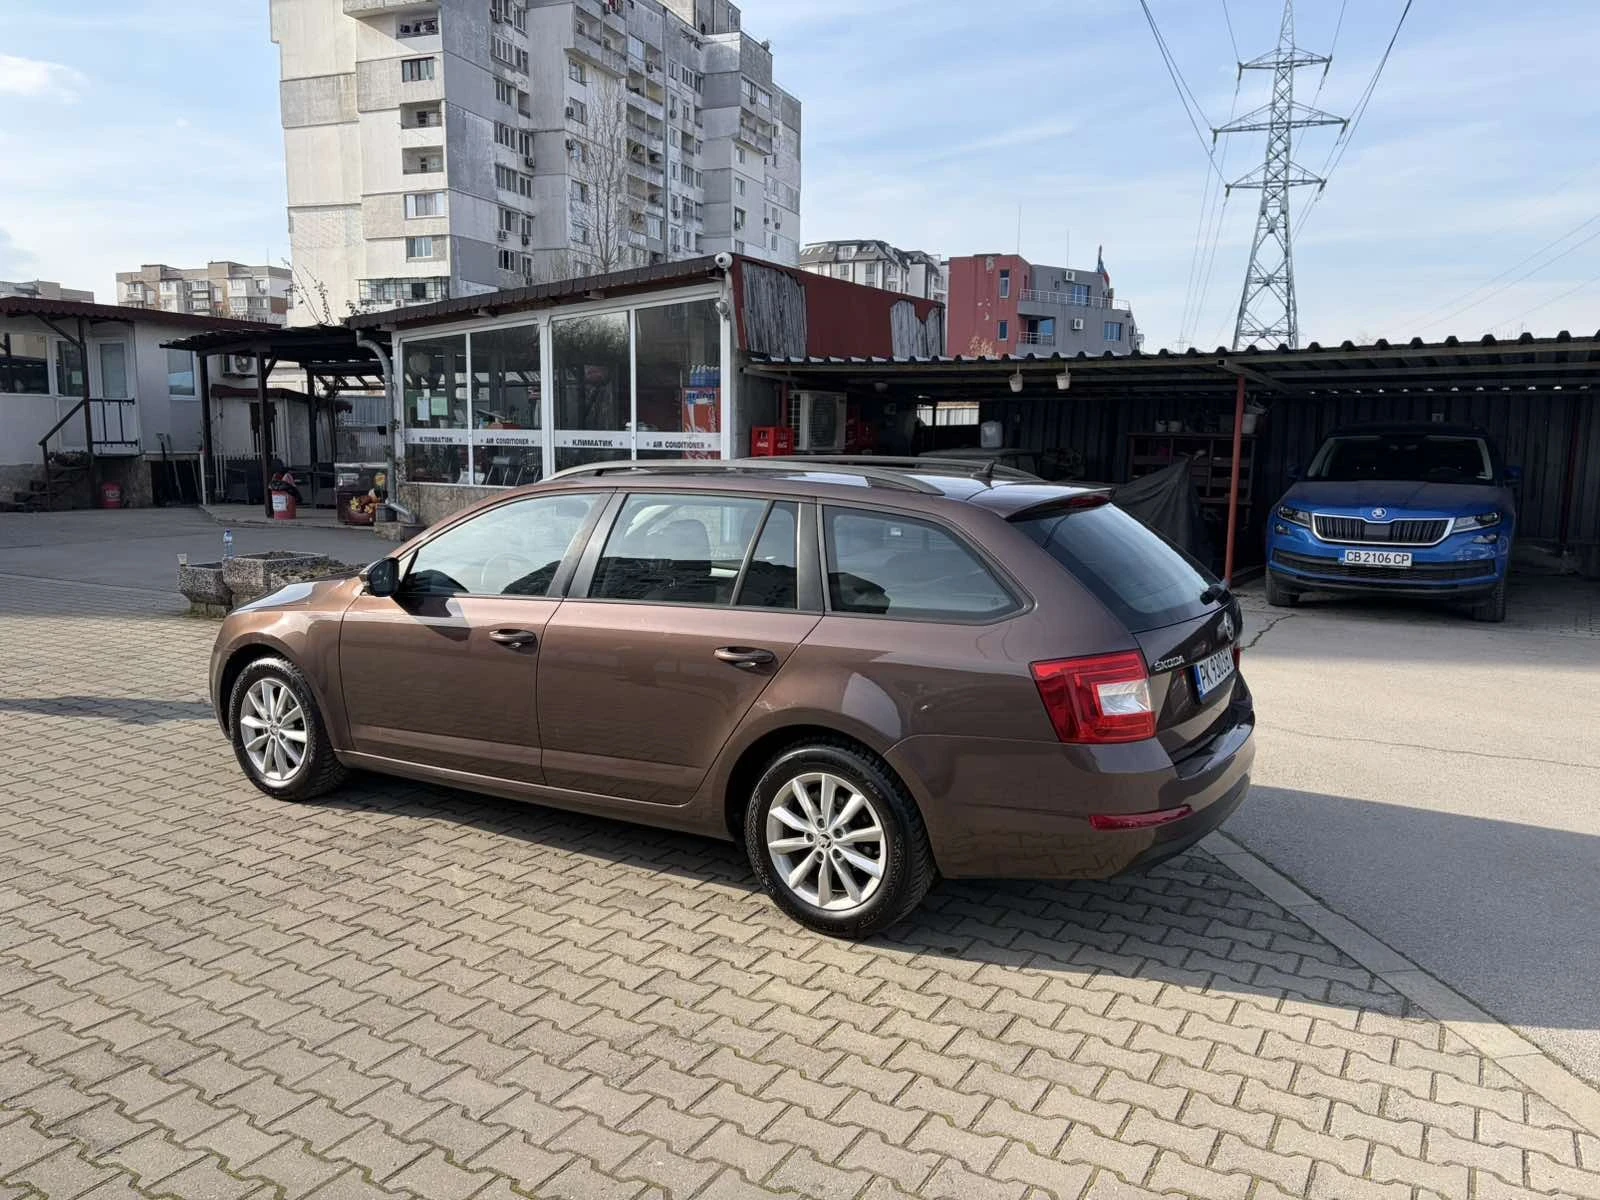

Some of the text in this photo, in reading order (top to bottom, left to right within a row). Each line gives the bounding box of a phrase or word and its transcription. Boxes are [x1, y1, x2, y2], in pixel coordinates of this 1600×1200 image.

[572, 439, 614, 447] КЛИМАТИК
[653, 440, 705, 449] AIR CONDITIONER
[1347, 552, 1410, 564] CB 2106 CP
